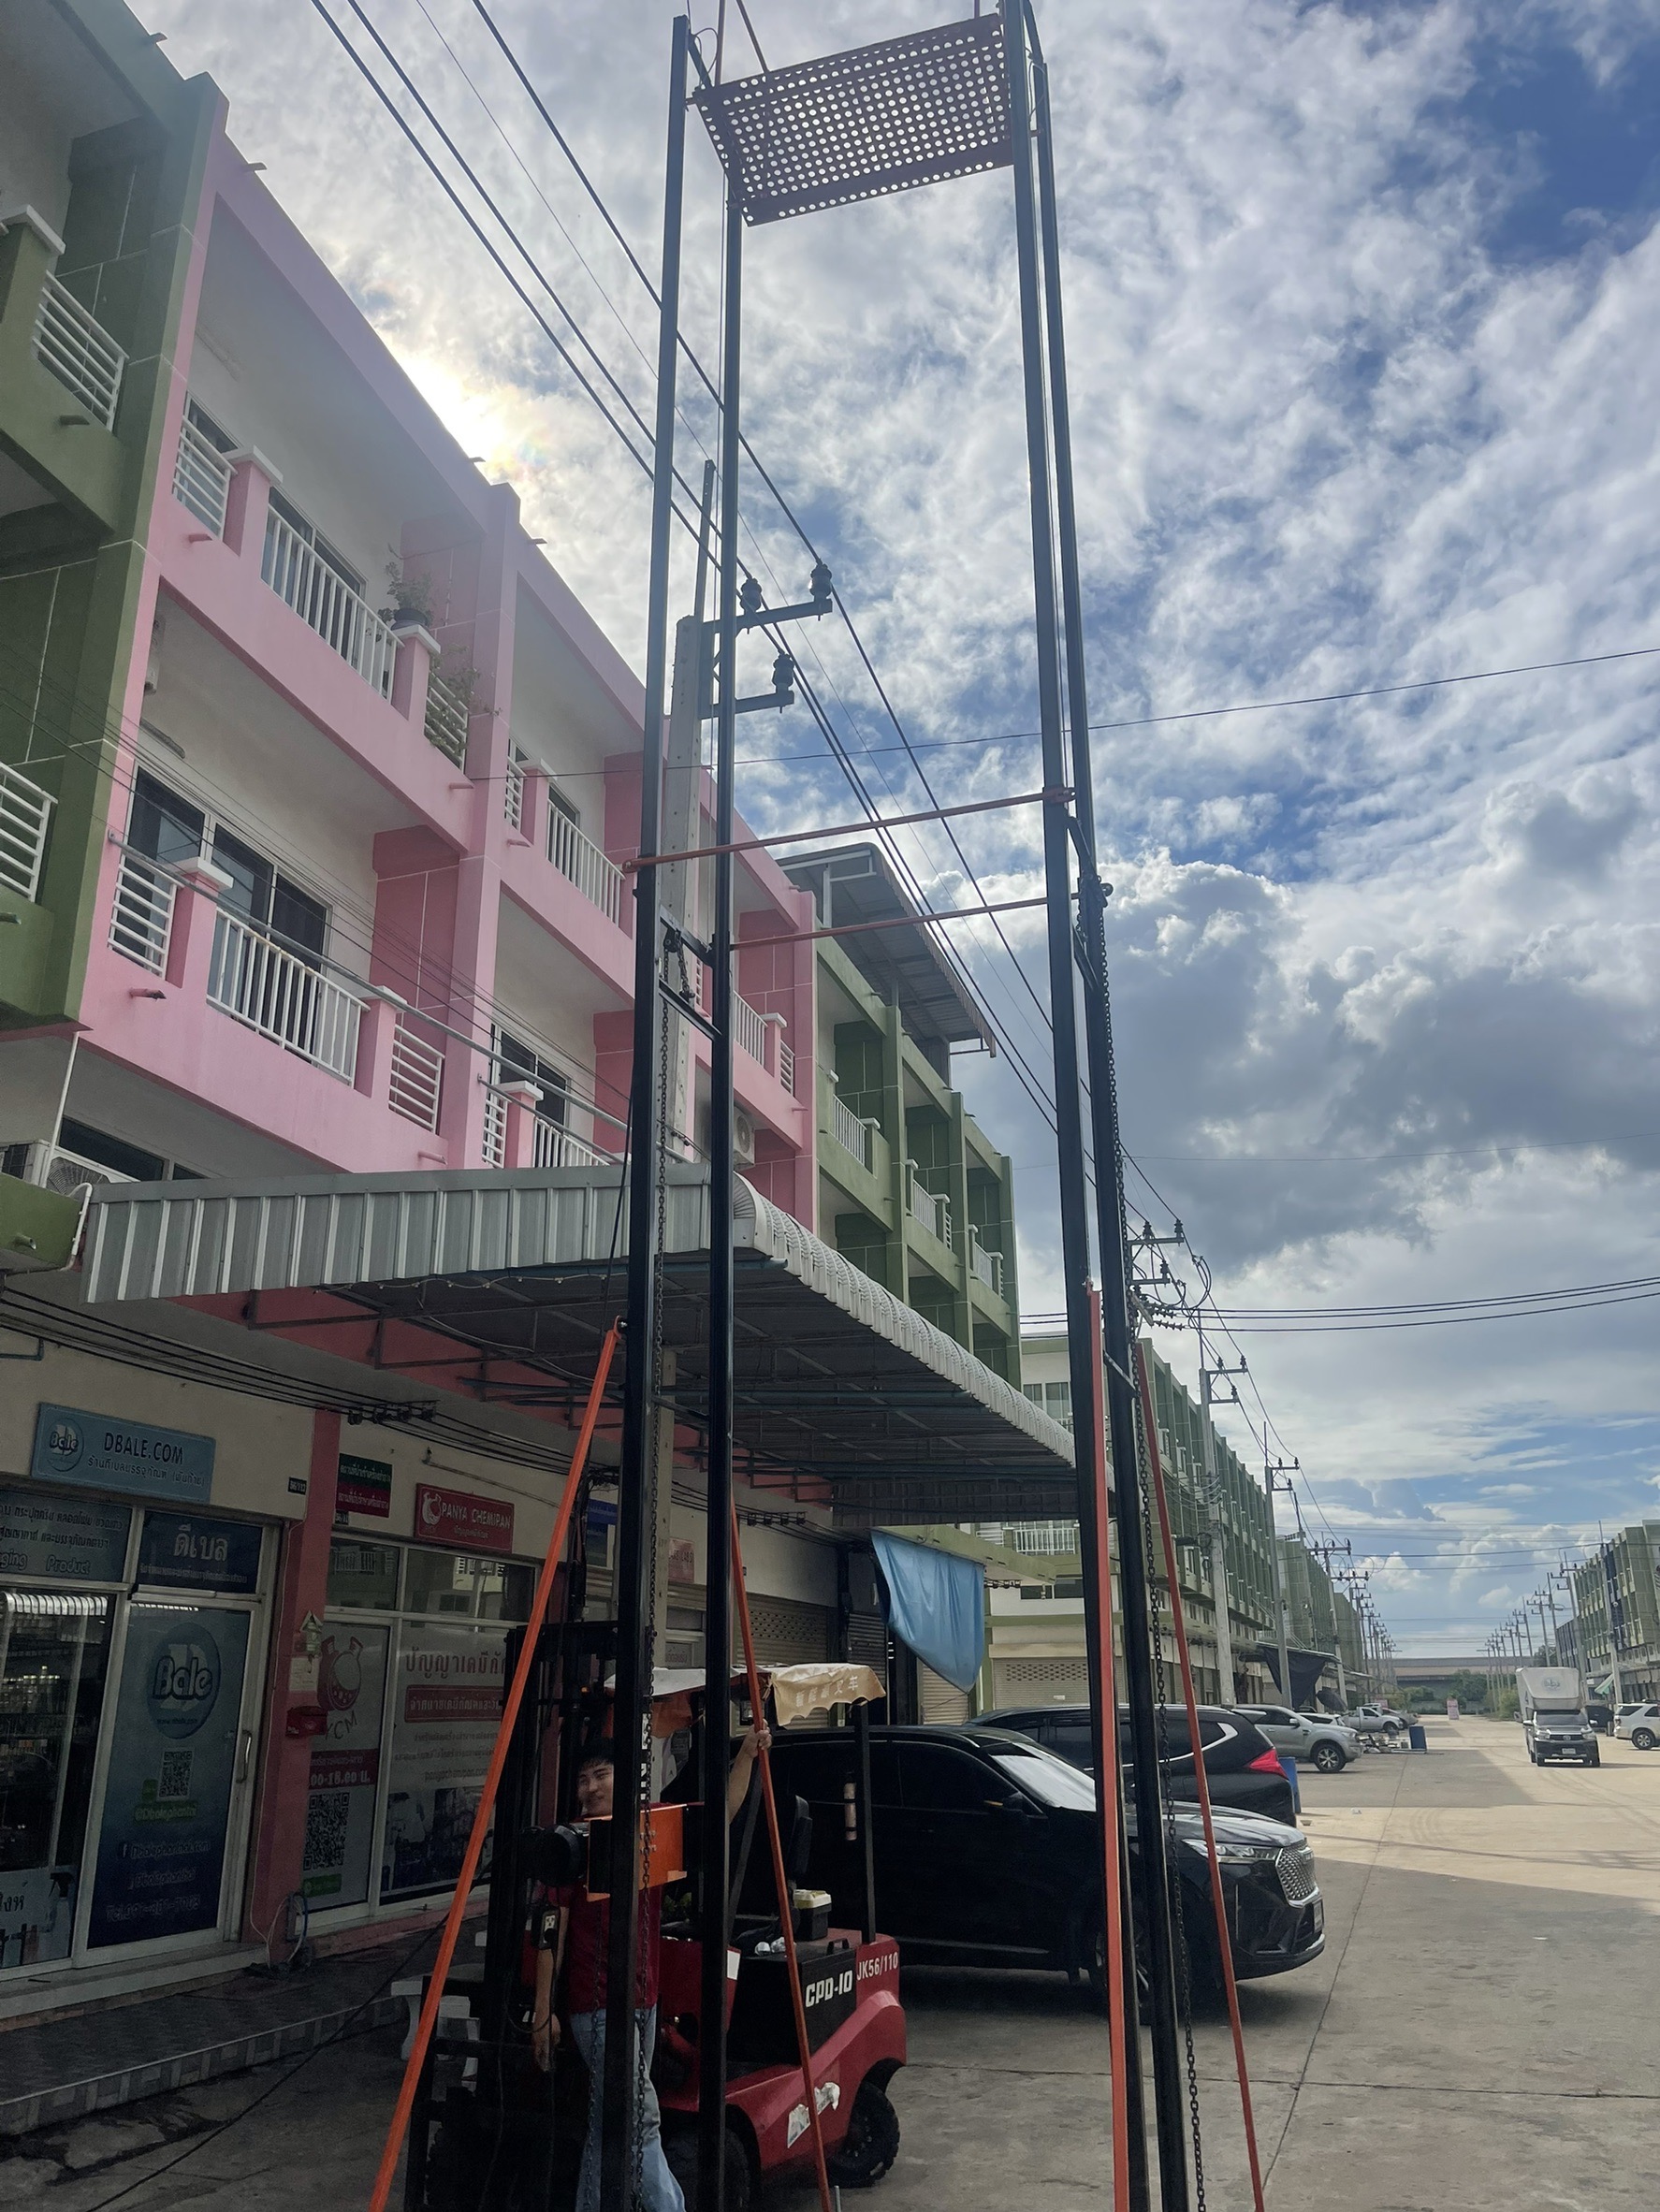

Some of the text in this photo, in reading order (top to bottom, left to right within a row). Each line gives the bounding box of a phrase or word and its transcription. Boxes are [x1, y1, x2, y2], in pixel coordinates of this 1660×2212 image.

[104, 1431, 183, 1464] DBALE.COM
[441, 1502, 512, 1529] PANYA CHEMIPAN
[173, 1523, 228, 1562] ดีเบล
[0, 1549, 91, 1575] ging Product
[153, 1655, 213, 1700] Bale
[406, 1646, 505, 1679] ปัญญาเคมีภั
[856, 1951, 899, 1982] JK56/110
